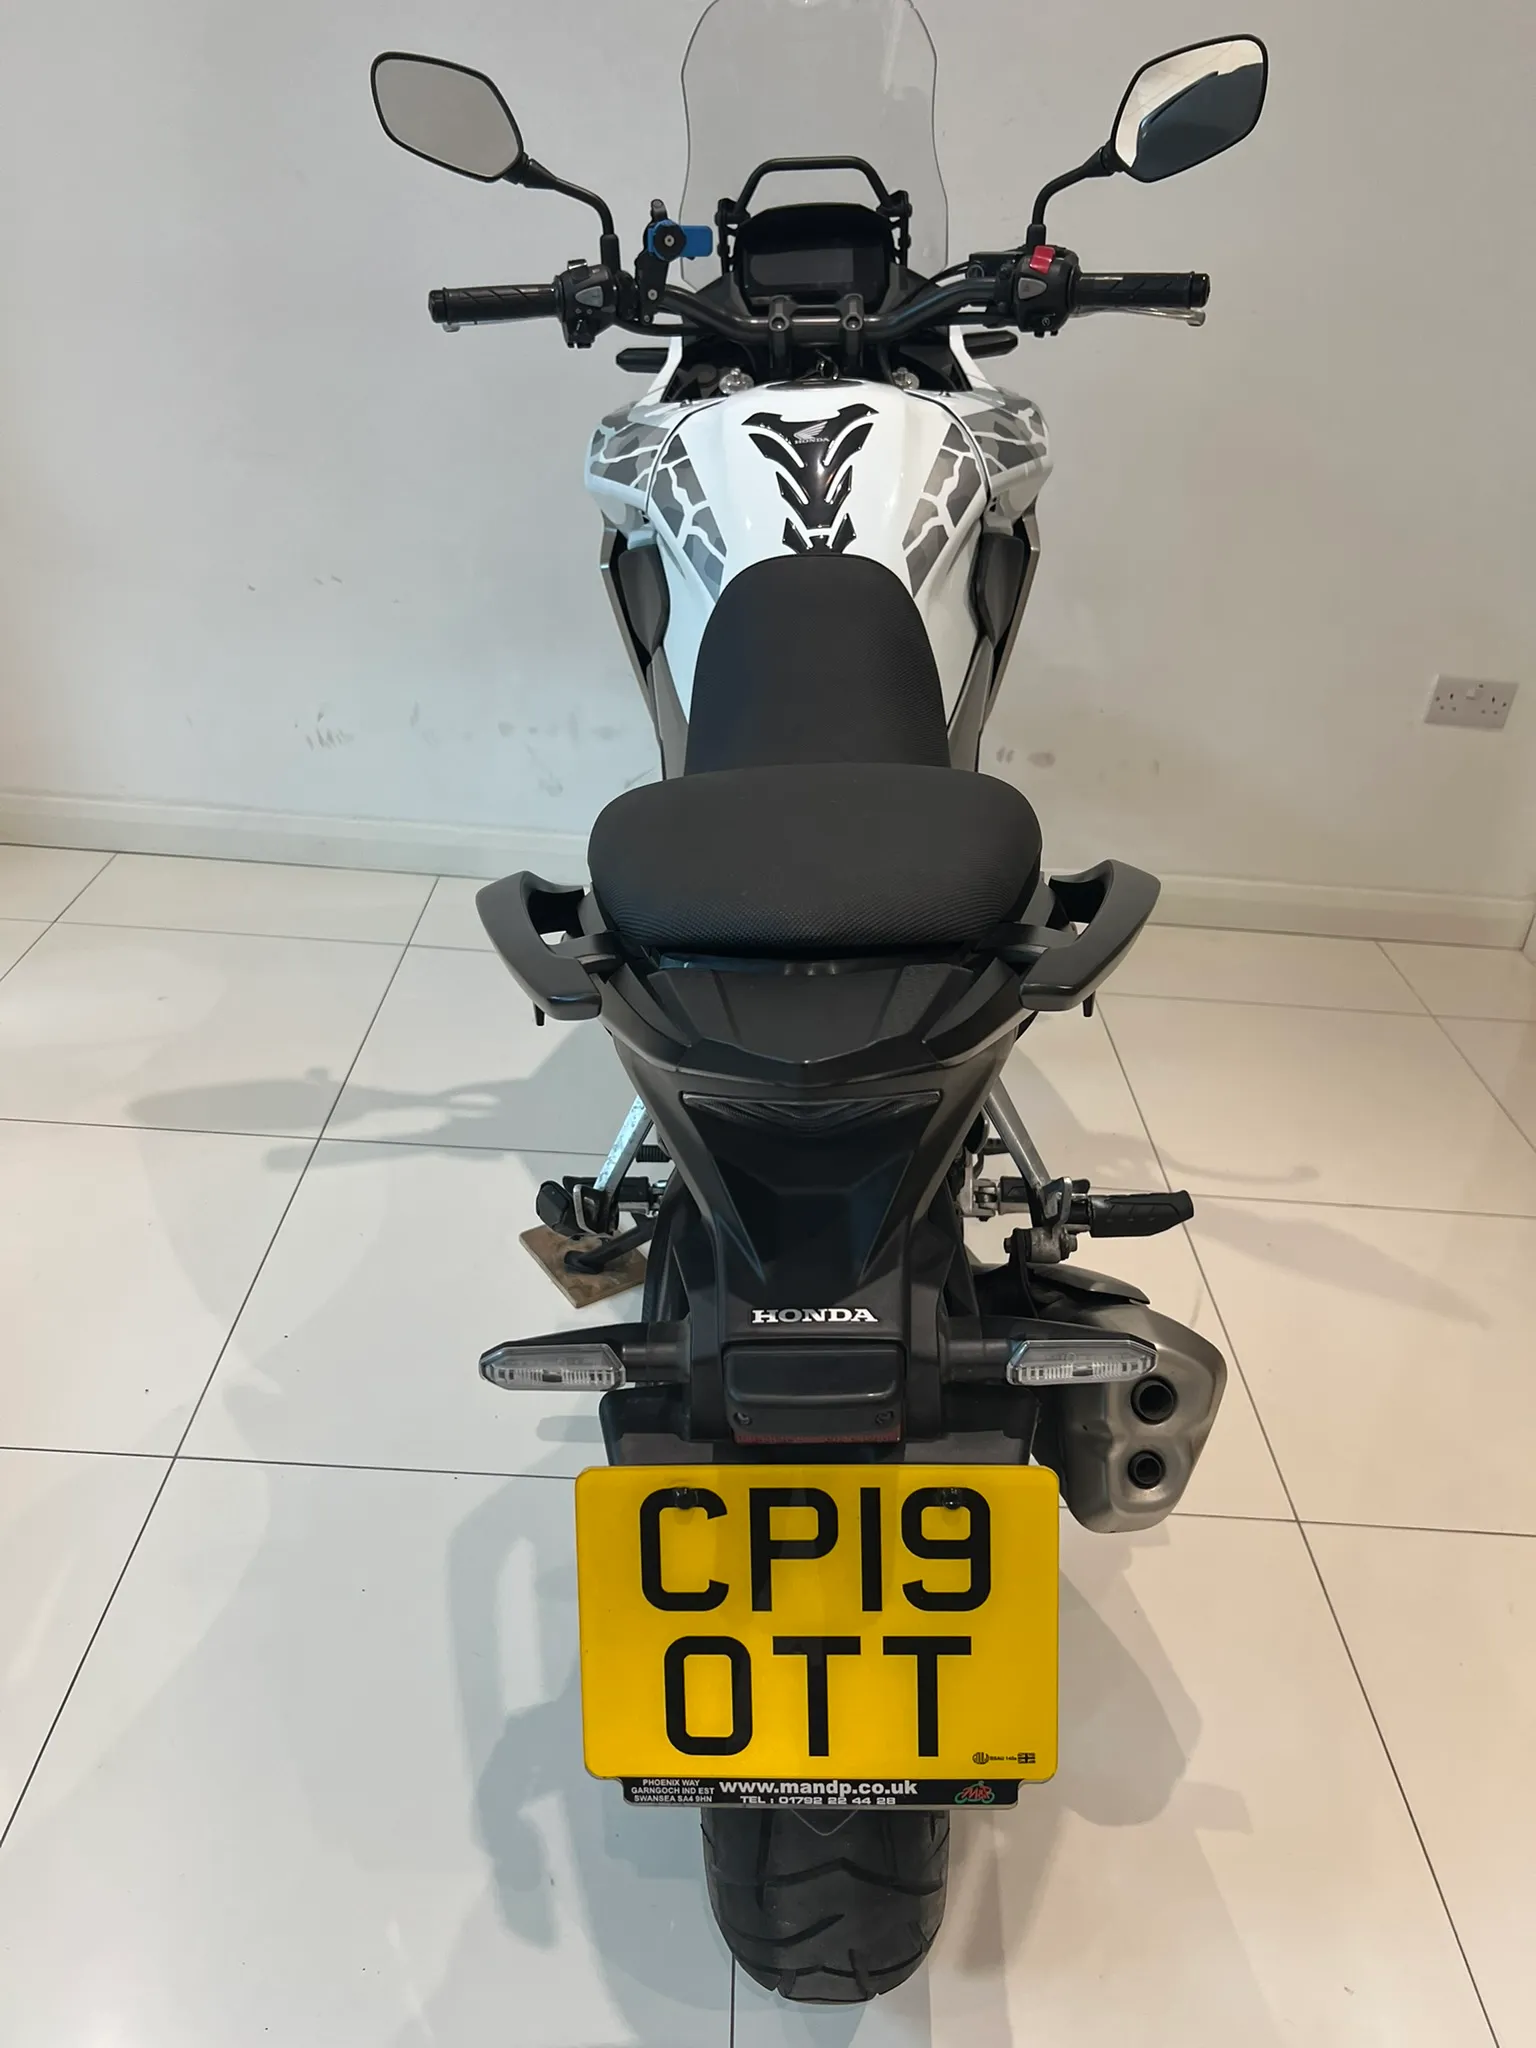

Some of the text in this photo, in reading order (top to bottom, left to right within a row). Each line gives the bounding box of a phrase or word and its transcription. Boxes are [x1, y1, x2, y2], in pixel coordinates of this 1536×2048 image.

[752, 1308, 878, 1323] HONDA
[639, 1487, 991, 1612] CP19
[664, 1636, 972, 1757] OTT
[642, 1779, 700, 1787] PHOENIX WAY
[719, 1780, 918, 1797] www.mandp.co.uk
[698, 1787, 715, 1795] EST
[695, 1795, 712, 1803] 9HN
[740, 1796, 766, 1804] TEL
[778, 1796, 823, 1805] 01792
[828, 1796, 847, 1805] 22
[851, 1797, 871, 1805] 44
[876, 1797, 896, 1805] 28
